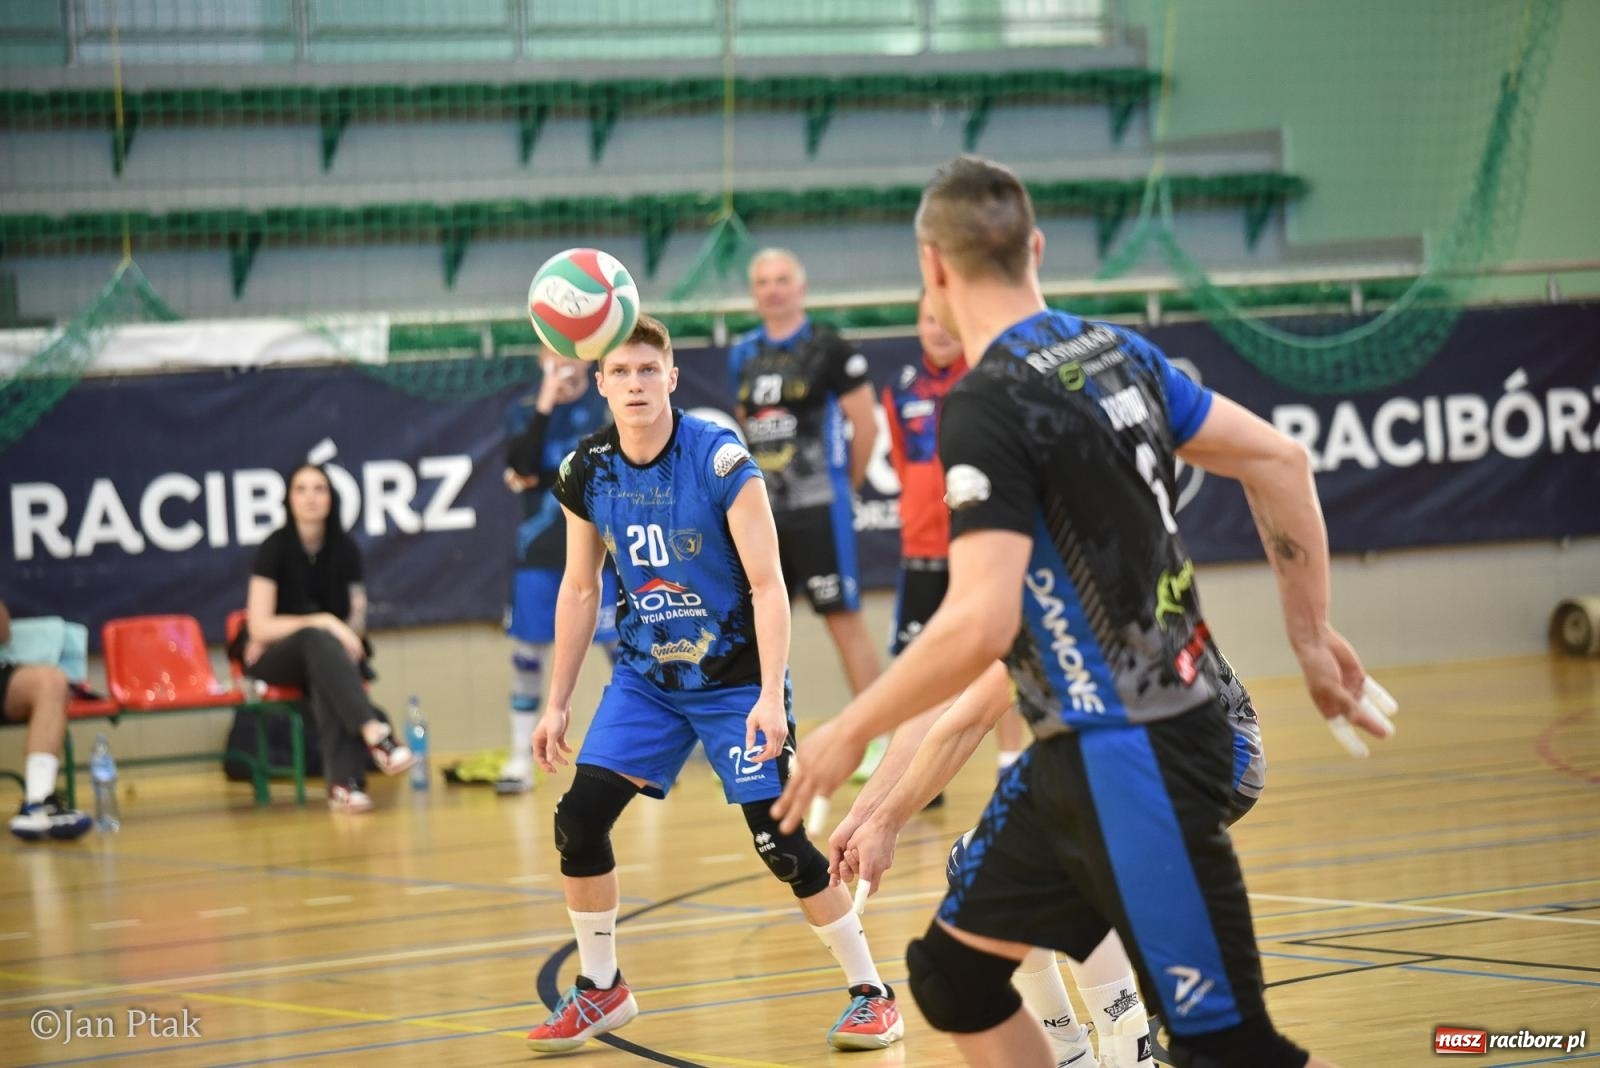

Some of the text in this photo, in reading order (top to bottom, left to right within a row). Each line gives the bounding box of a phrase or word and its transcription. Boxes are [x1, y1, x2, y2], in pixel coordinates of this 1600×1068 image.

[1271, 367, 1600, 473] RACIBÓR
[626, 524, 670, 567] 20
[665, 608, 708, 620] DACHOWE
